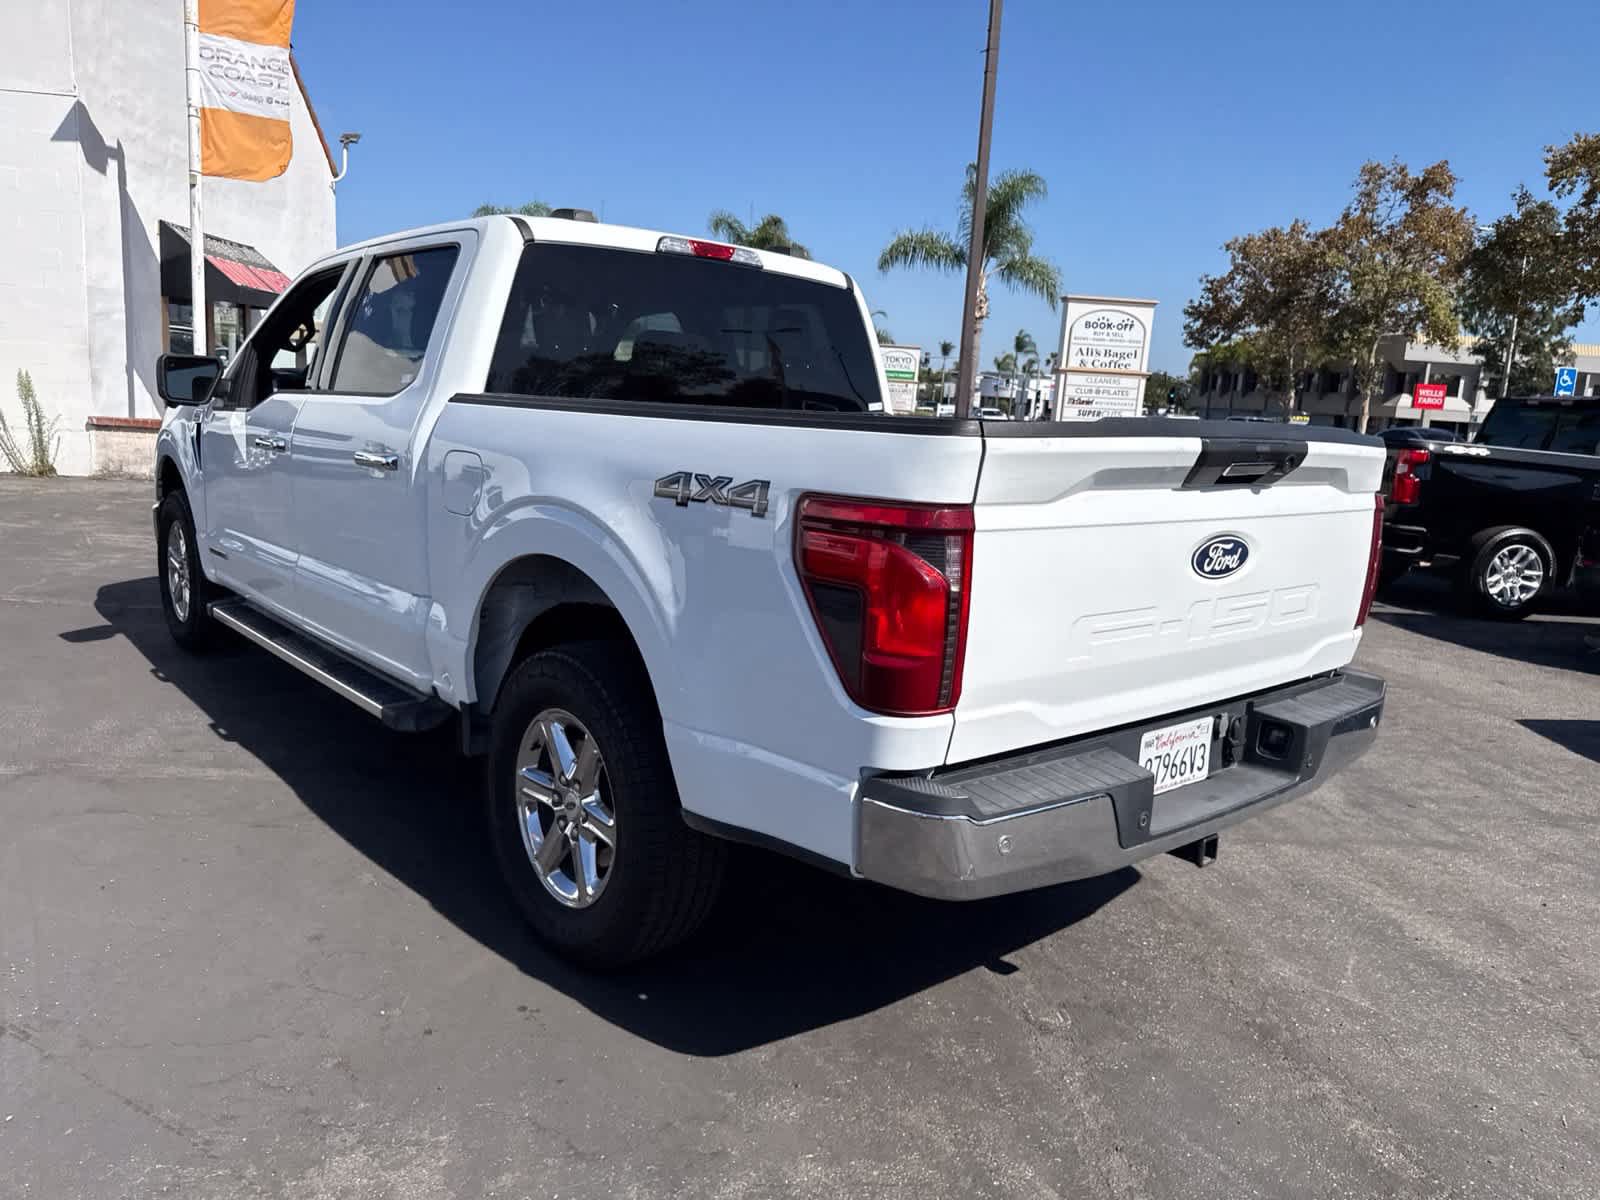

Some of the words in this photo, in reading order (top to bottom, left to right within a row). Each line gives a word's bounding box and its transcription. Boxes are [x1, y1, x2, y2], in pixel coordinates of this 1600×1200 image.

[199, 46, 289, 76] ORANGE
[208, 63, 288, 89] COAST
[886, 355, 912, 364] TOKYO
[1104, 348, 1137, 360] Bagel
[1079, 359, 1087, 367] &
[1091, 359, 1131, 368] Coffee
[1419, 389, 1443, 397] WELLS
[1418, 397, 1443, 405] FARGO
[1203, 542, 1240, 573] Ford
[1066, 582, 1320, 662] F-150
